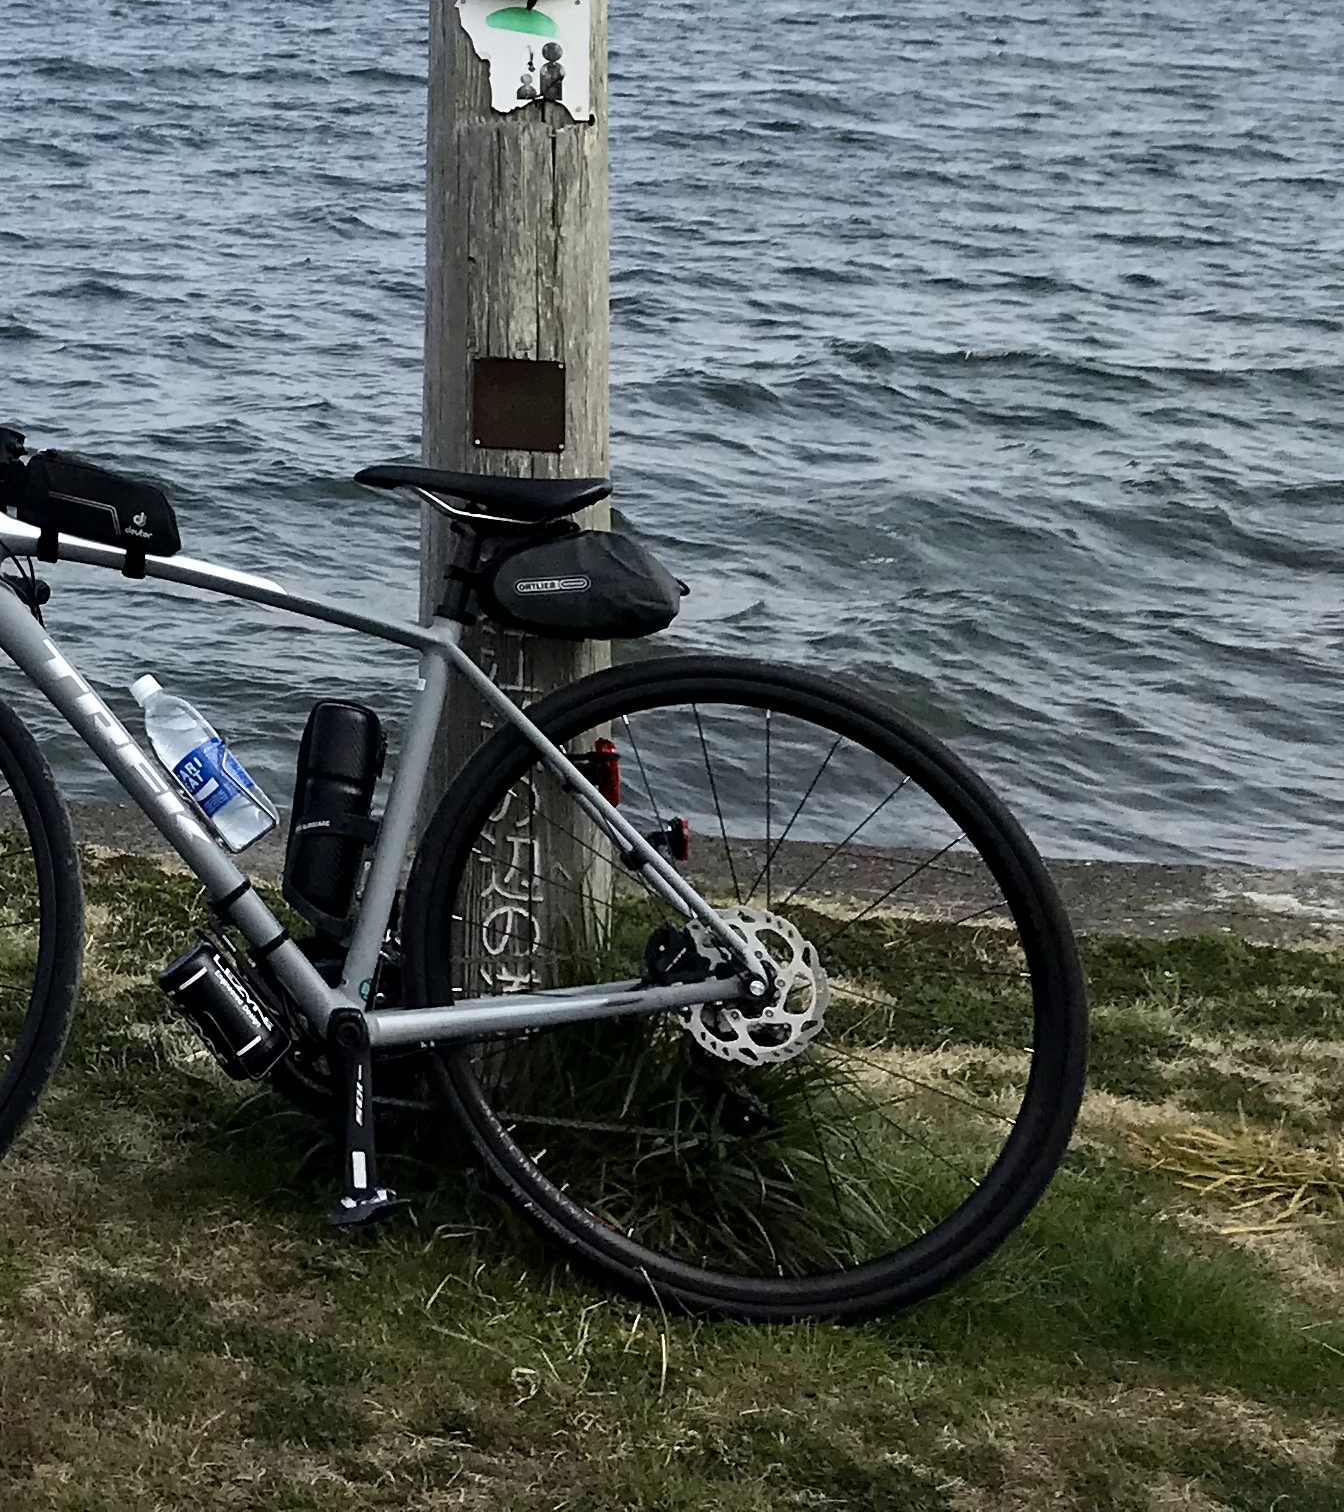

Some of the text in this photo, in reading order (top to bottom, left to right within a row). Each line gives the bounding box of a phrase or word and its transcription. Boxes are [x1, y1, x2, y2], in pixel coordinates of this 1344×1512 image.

[517, 580, 558, 593] ORTLIEB
[42, 638, 212, 844] TREK
[177, 756, 203, 782] ARI
[213, 953, 274, 1032] LEZYNE
[214, 969, 262, 1028] Engineered Design
